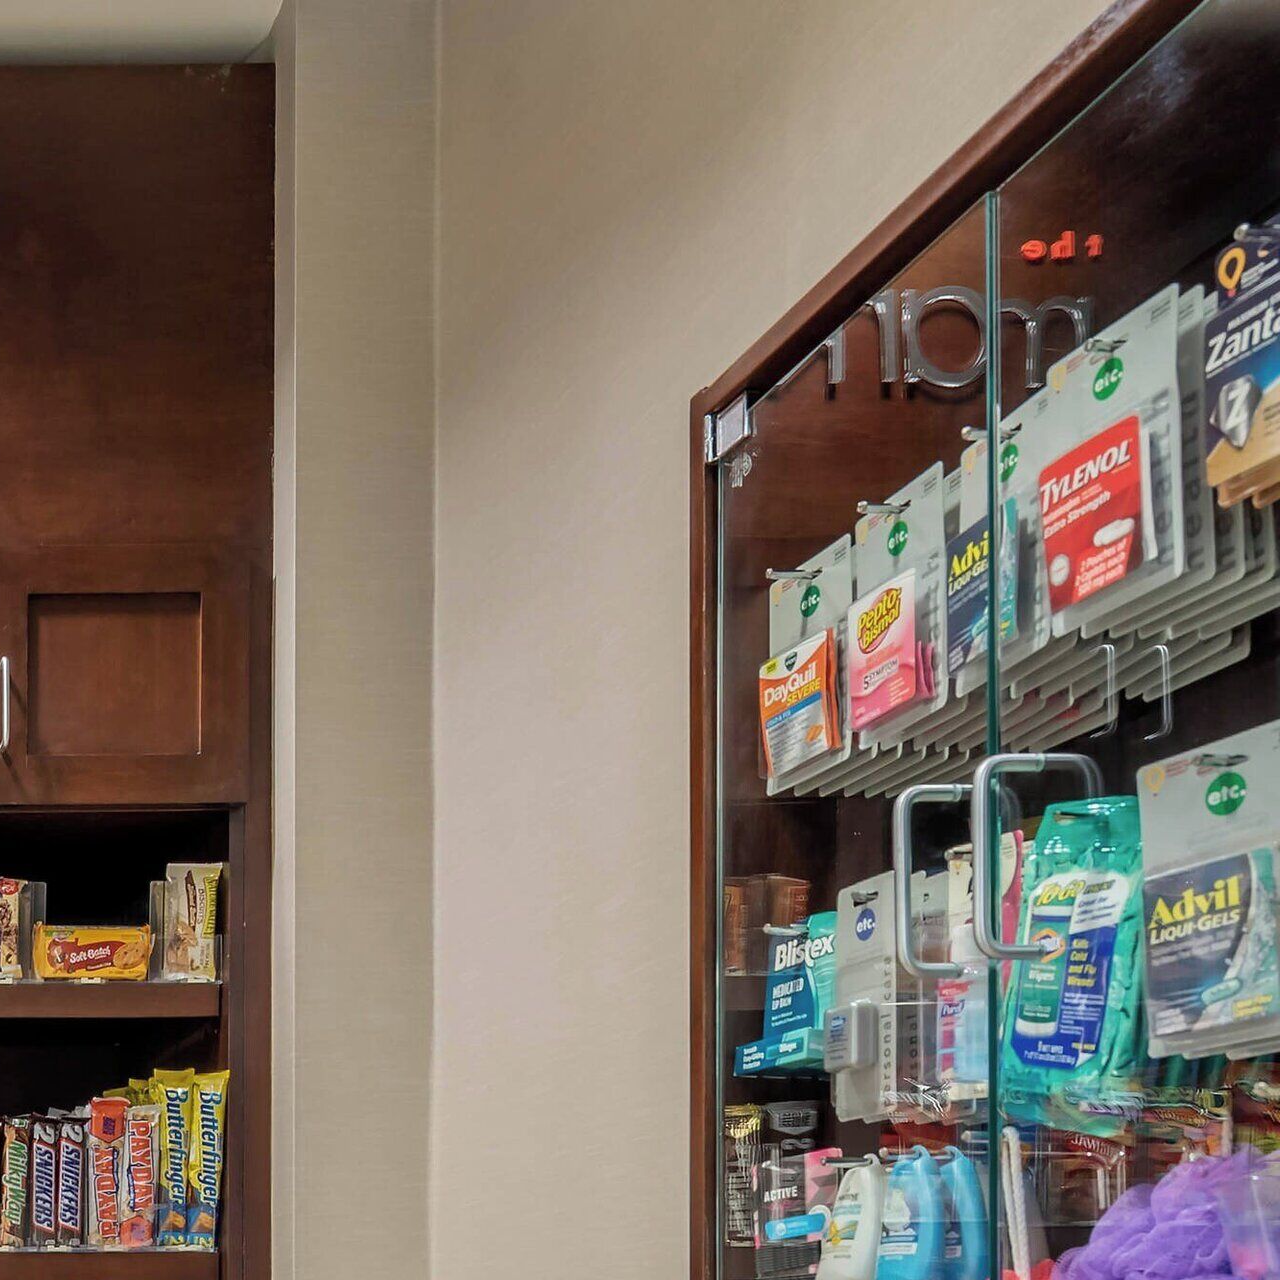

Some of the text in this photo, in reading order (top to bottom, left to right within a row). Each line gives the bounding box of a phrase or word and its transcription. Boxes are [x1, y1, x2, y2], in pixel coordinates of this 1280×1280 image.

[1040, 440, 1133, 514] TYLENOL
[1066, 490, 1111, 528] Strength
[861, 600, 901, 651] Bismol
[763, 661, 817, 708] DayQuil
[785, 676, 822, 707] SEVERE
[1207, 776, 1247, 806] etc.
[1148, 872, 1244, 932] Advil
[855, 918, 877, 934] etc.
[1148, 907, 1242, 947] LIQUI-GELS
[69, 945, 111, 964] Soft Batch
[774, 933, 835, 972] Blistex
[1069, 951, 1089, 961] Cold
[3, 1140, 28, 1183] Milky
[128, 1119, 154, 1218] PAYDAY
[165, 1087, 189, 1206] Butterfinger
[198, 1088, 223, 1208] Butterfinger
[34, 1145, 56, 1230] SNICKERS
[61, 1143, 83, 1229] SNICKERS
[93, 1144, 119, 1238] PAYDAY
[763, 1185, 799, 1203] ACTIVE
